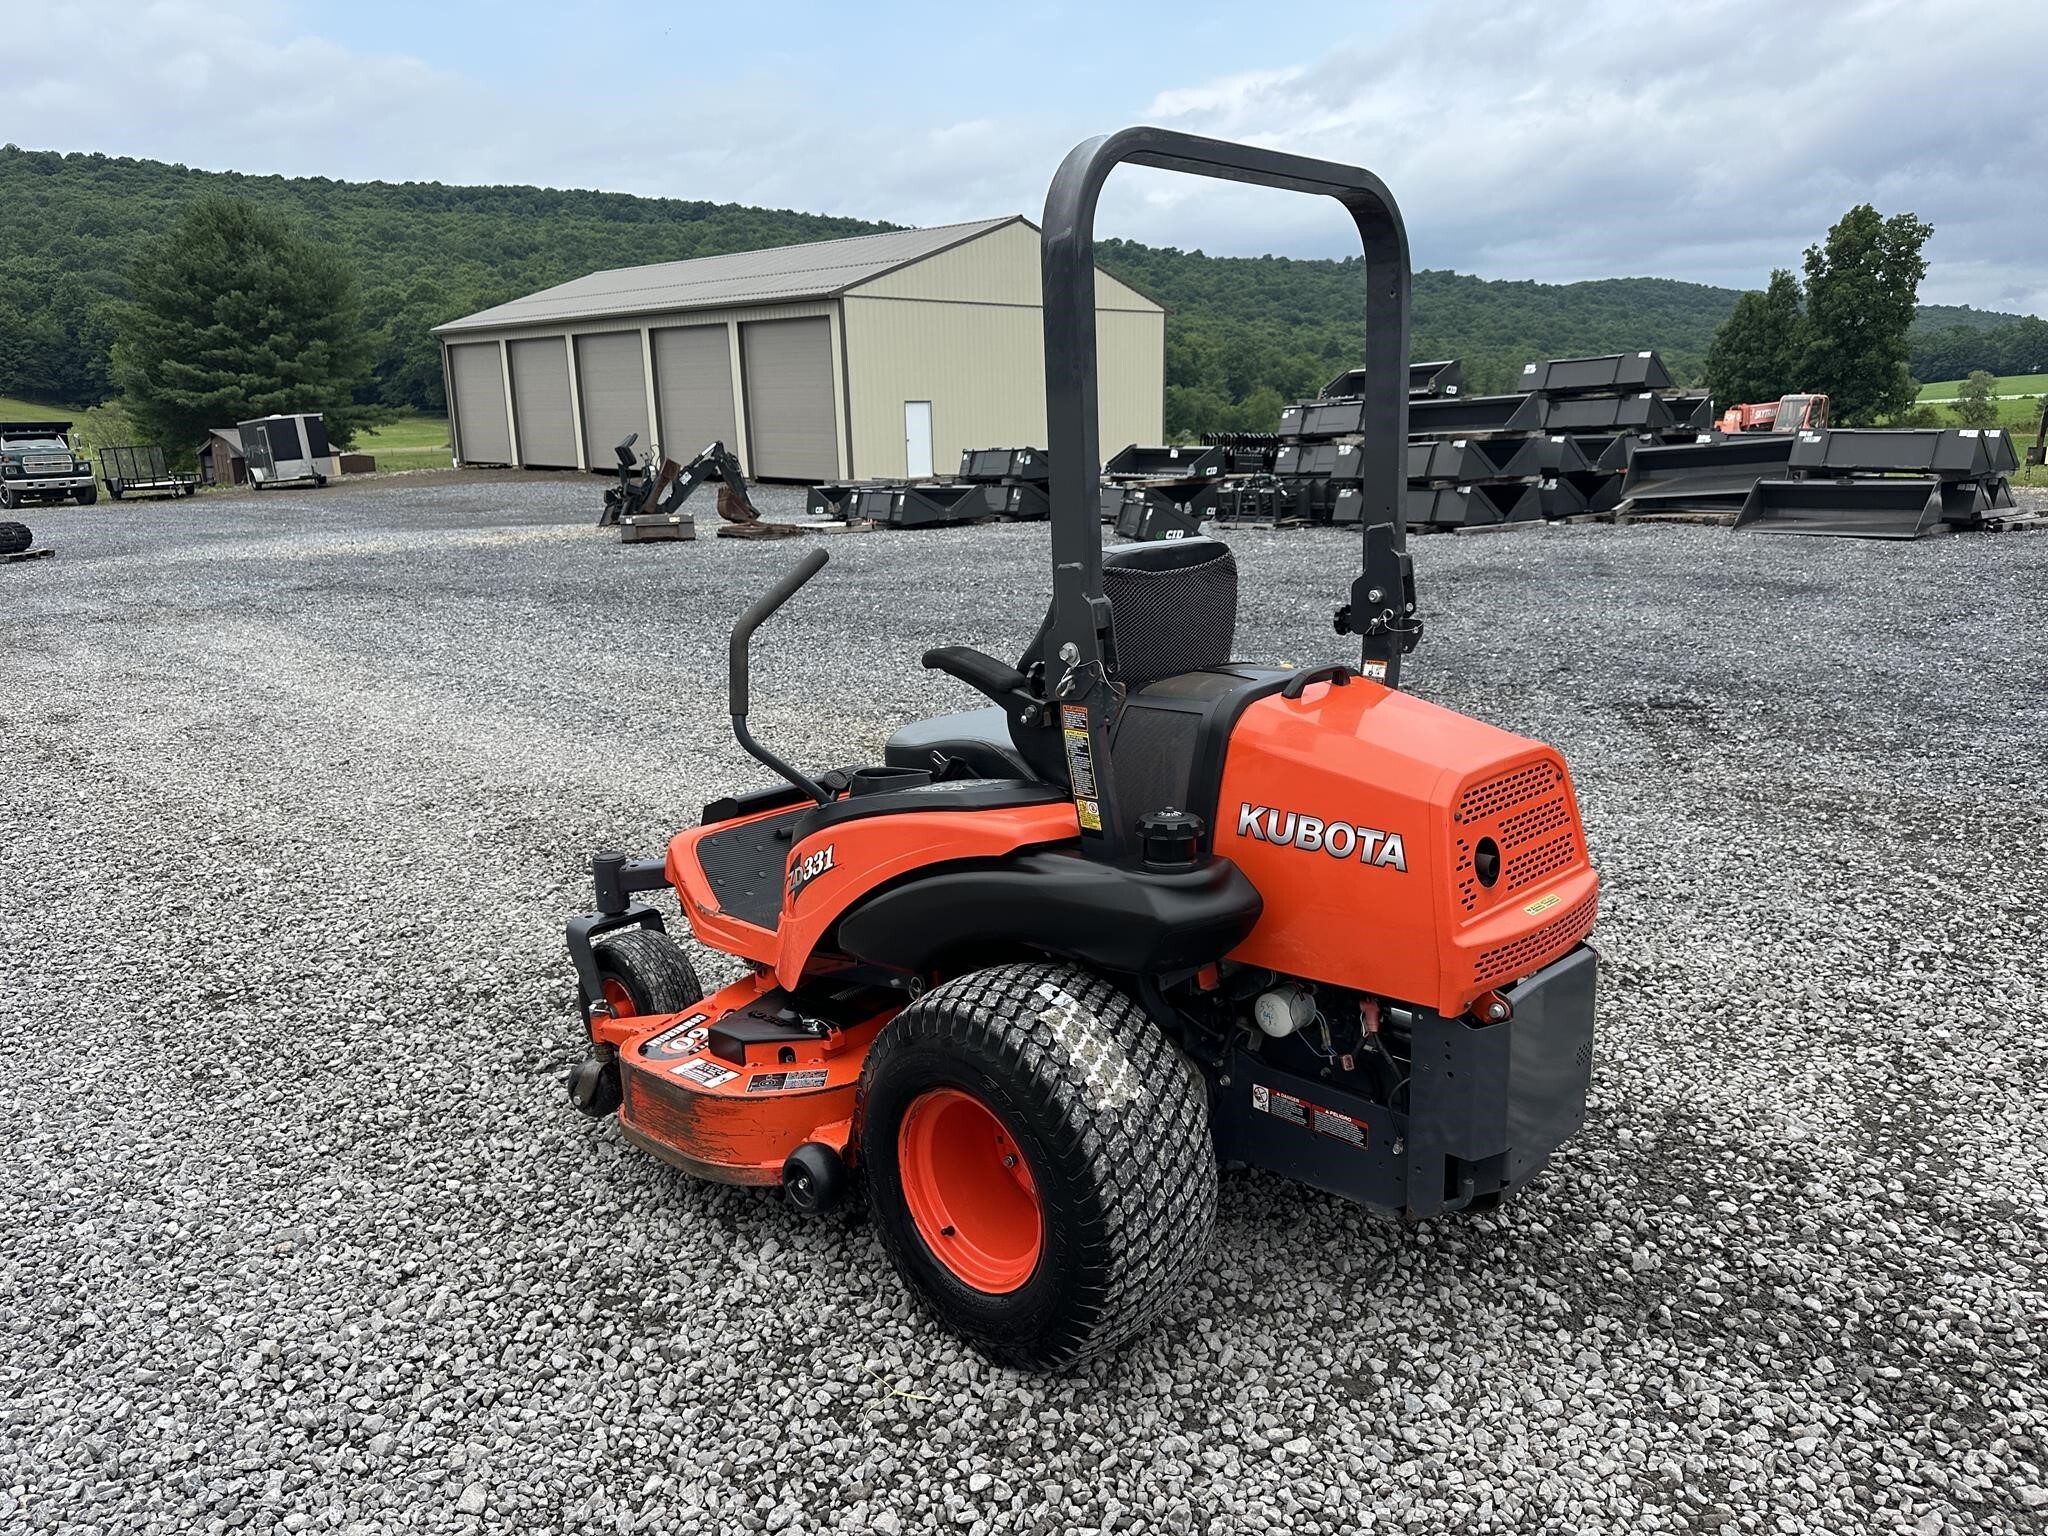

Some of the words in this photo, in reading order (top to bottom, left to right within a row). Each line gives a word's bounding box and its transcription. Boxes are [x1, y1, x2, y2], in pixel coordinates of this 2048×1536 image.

[1165, 529, 1185, 540] CID
[1237, 802, 1408, 873] KUBOTA
[787, 843, 835, 892] ZD331
[669, 1027, 709, 1050] 60
[1280, 1093, 1300, 1103] DANGER
[1329, 1110, 1352, 1123] PELIGRO
